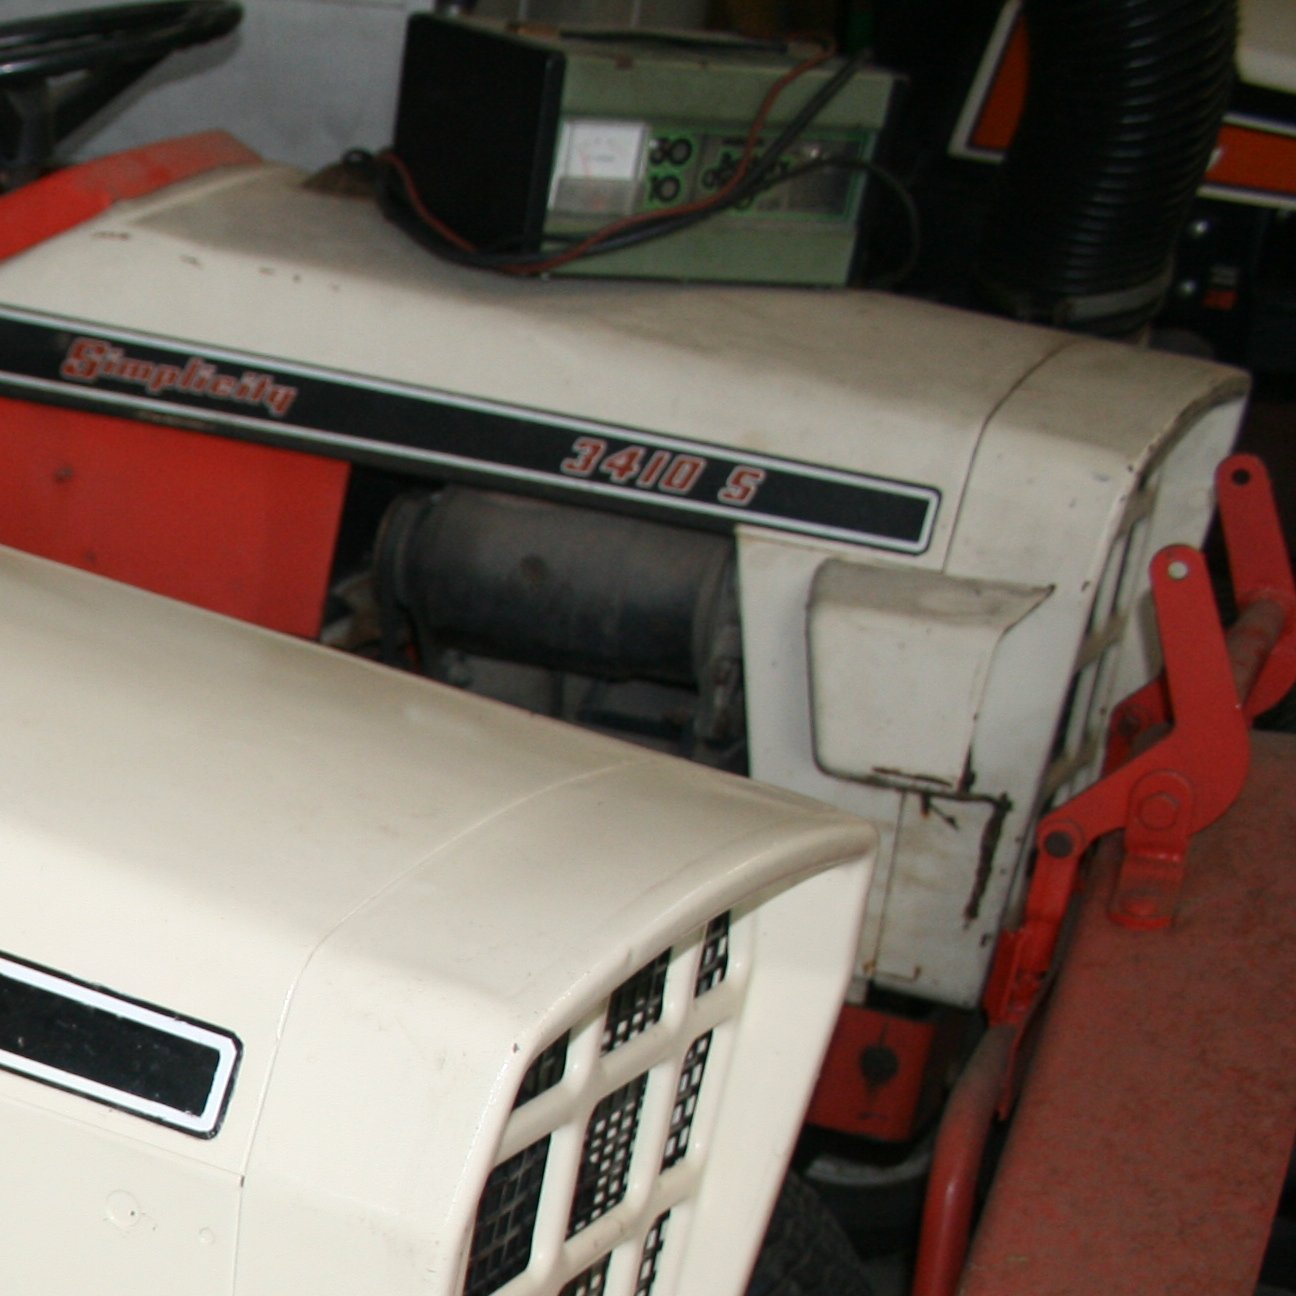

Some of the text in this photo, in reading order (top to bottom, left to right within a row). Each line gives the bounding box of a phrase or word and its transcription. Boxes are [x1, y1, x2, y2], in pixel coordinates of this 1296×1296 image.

[61, 336, 298, 416] Simplicity
[561, 436, 765, 508] 3410 S
